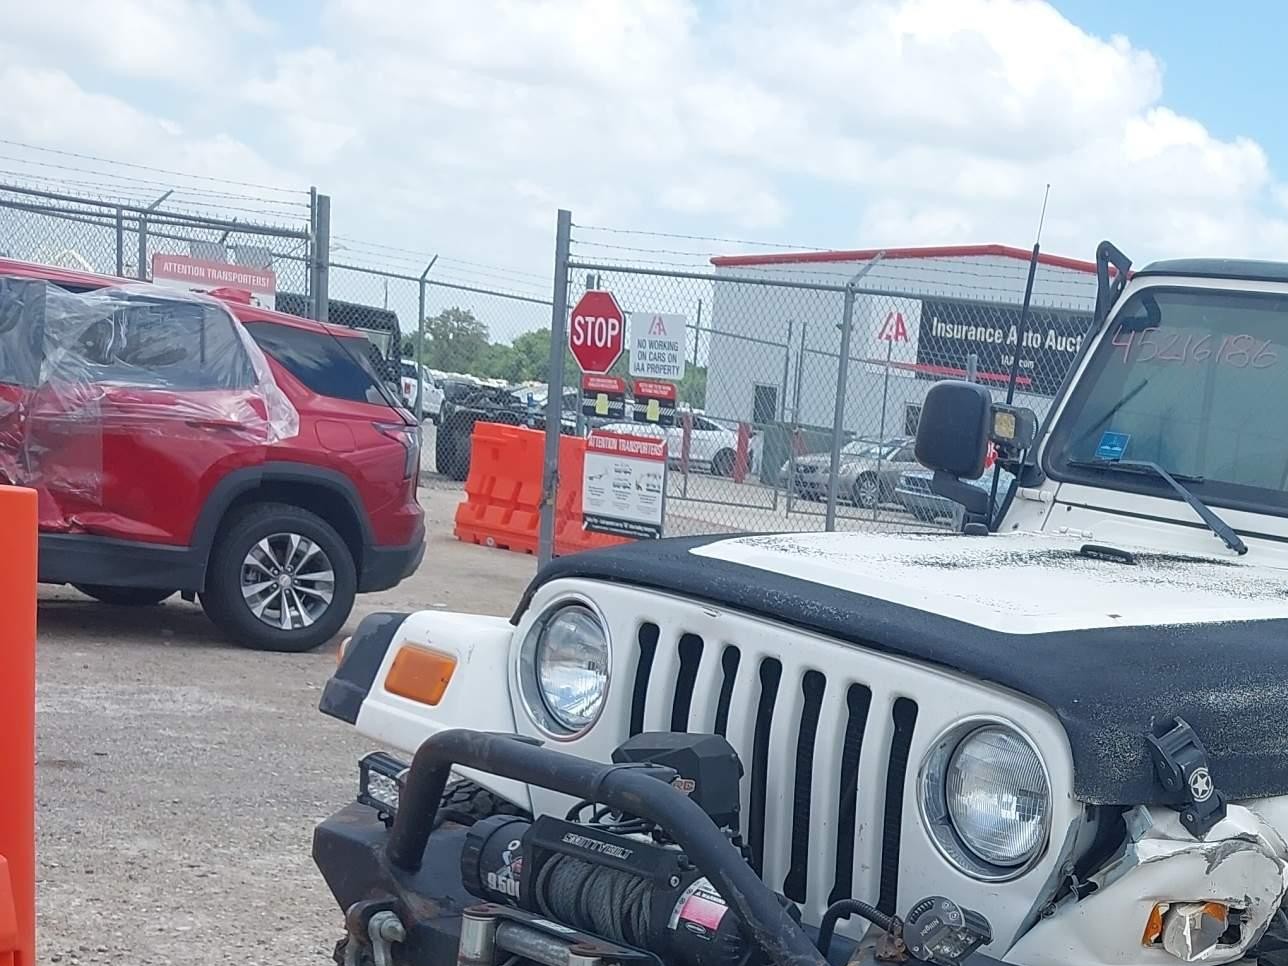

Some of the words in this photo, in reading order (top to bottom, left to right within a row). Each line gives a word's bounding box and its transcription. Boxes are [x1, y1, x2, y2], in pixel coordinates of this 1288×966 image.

[163, 262, 205, 277] ATTENTION
[207, 268, 270, 288] TRANSPORTERS!
[573, 315, 620, 348] STOP
[932, 317, 1003, 344] Insurance
[1044, 329, 1084, 353] Auct
[637, 339, 647, 349] NO
[649, 340, 679, 352] WORKING
[637, 350, 647, 361] ON
[648, 351, 666, 362] CARS
[667, 353, 677, 363] ON
[1112, 324, 1279, 369] 45216186
[634, 362, 645, 373] IAA
[646, 363, 680, 375] PROPERTY
